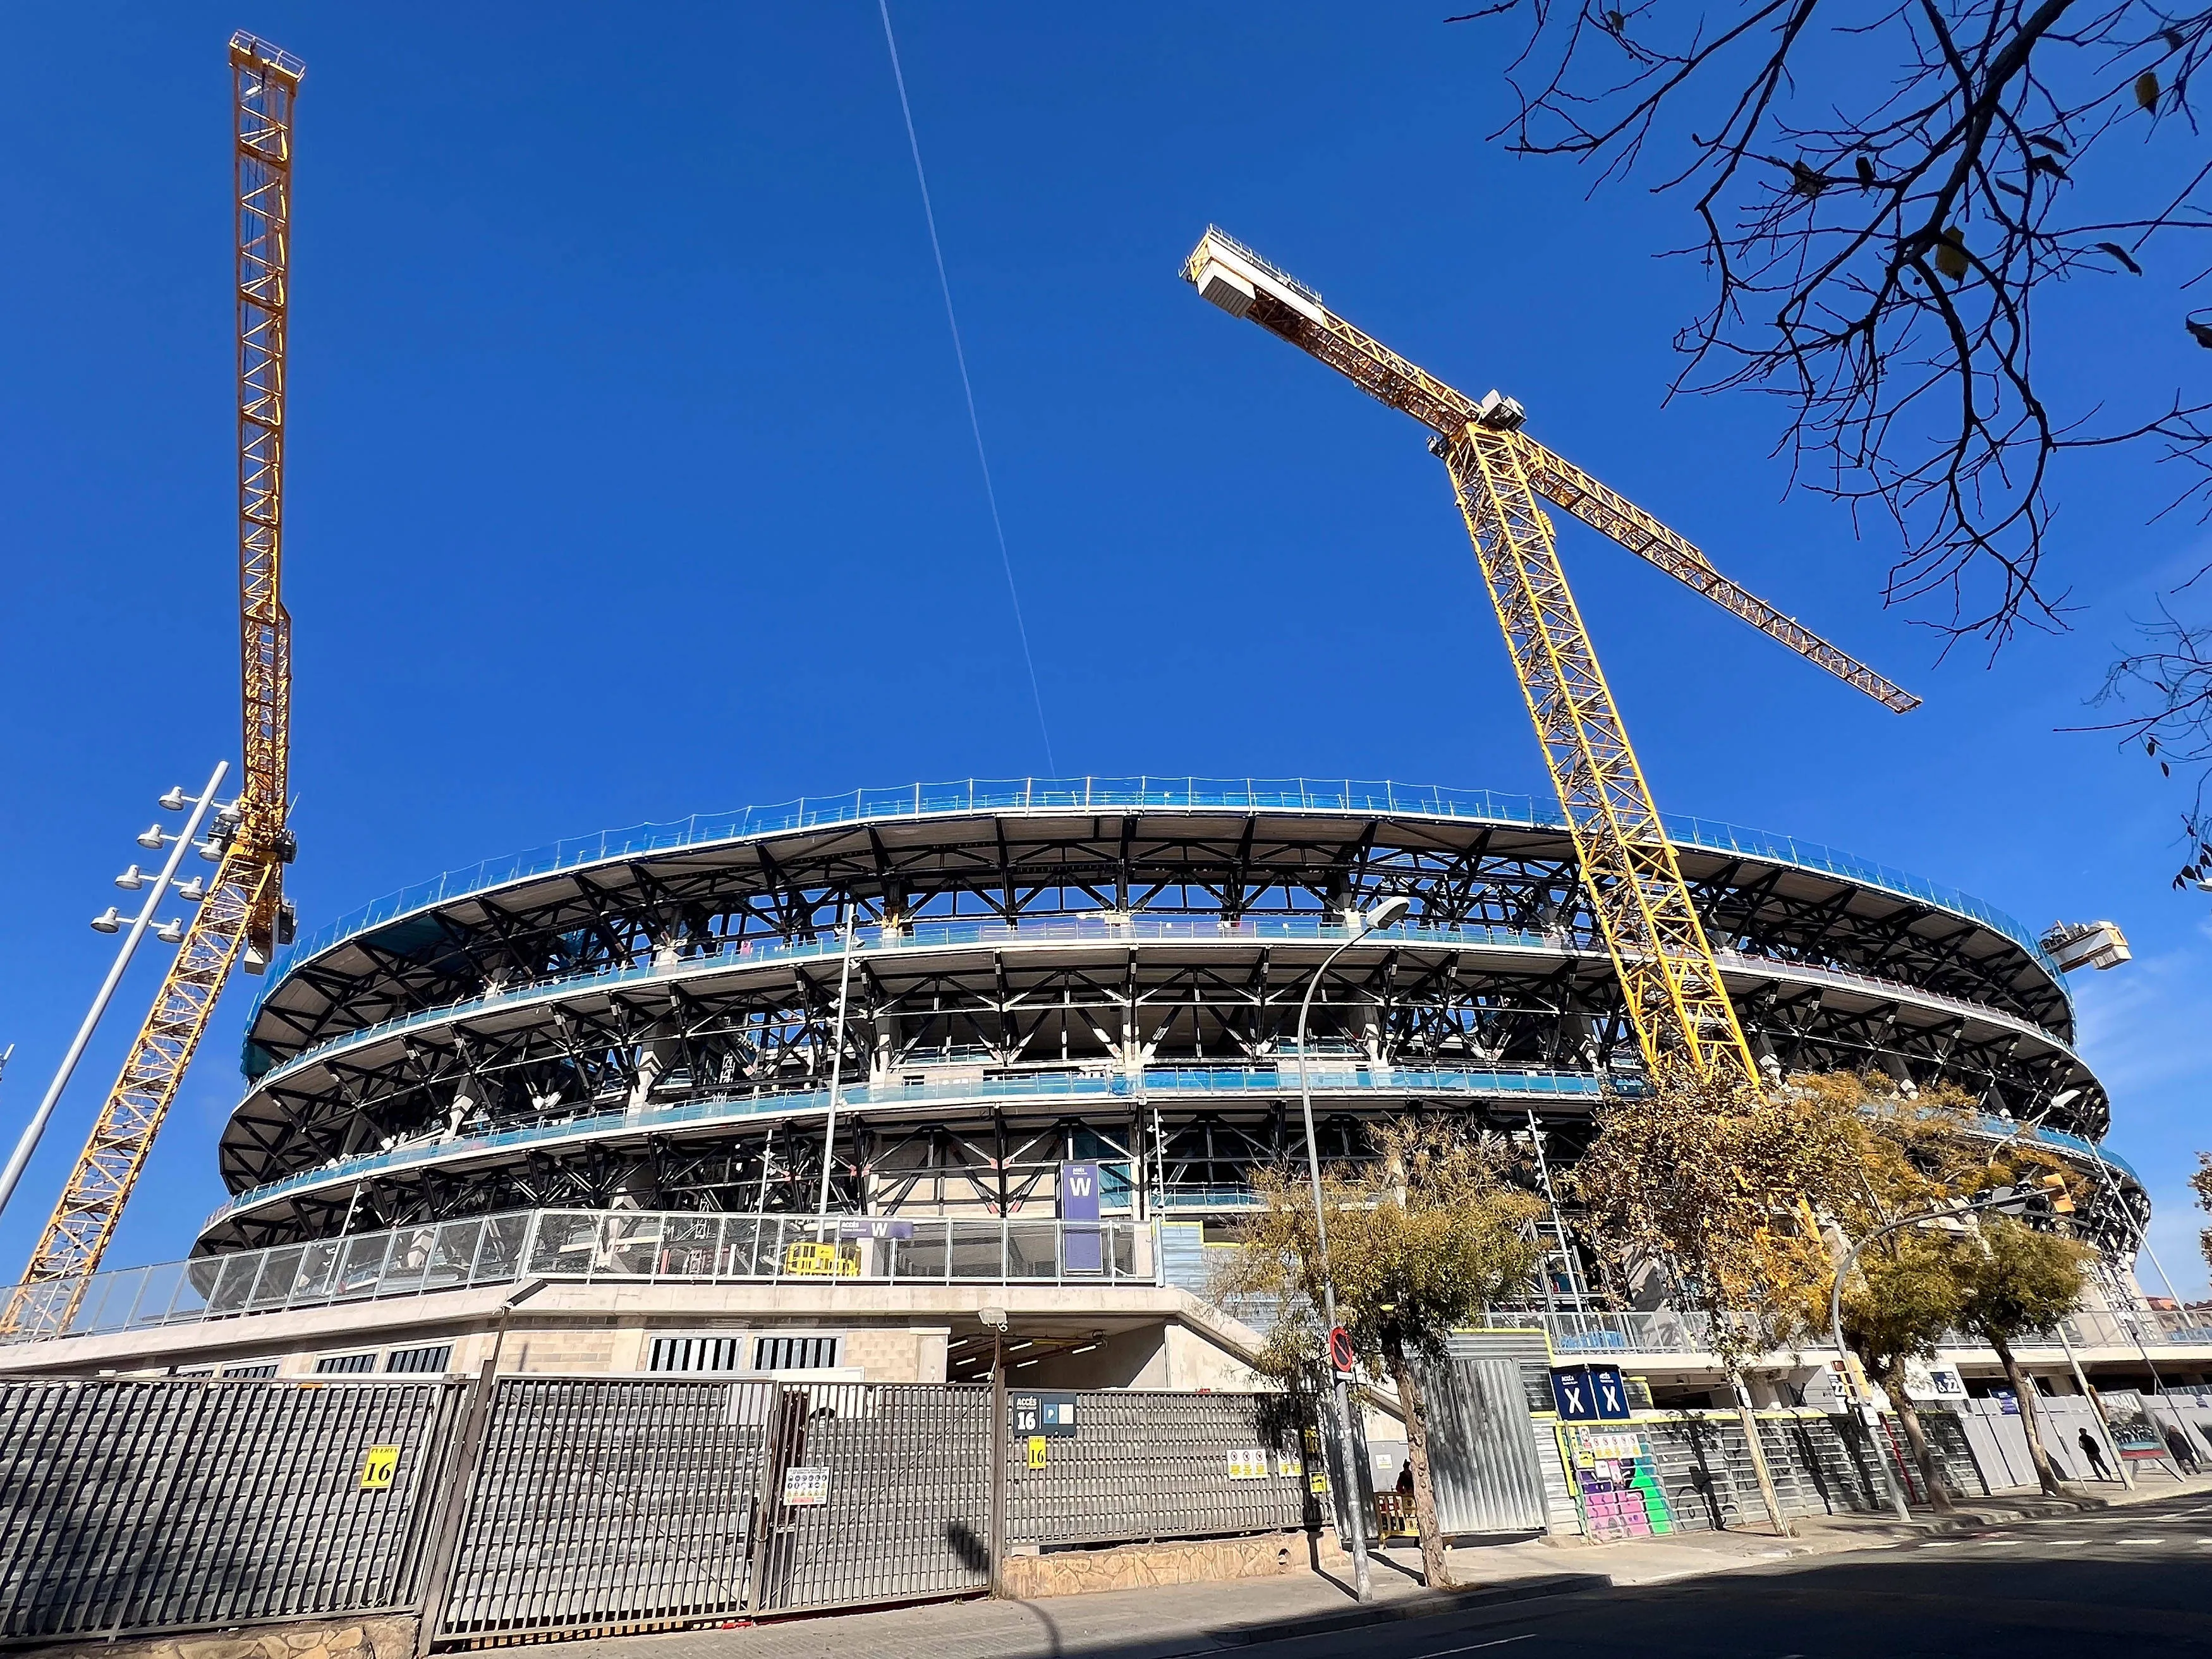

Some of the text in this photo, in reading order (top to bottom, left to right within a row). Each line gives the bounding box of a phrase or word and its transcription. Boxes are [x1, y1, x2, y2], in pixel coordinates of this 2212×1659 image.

[1069, 1177, 1091, 1196] W
[871, 1222, 888, 1237] W
[1943, 1378, 1960, 1392] 22
[1016, 1395, 1037, 1406] ACCÉS
[1564, 1387, 1584, 1414] X
[1602, 1385, 1620, 1412] X
[1018, 1411, 1036, 1430] 16
[1047, 1409, 1055, 1419] P
[1030, 1449, 1044, 1463] 16
[363, 1462, 392, 1481] 16
